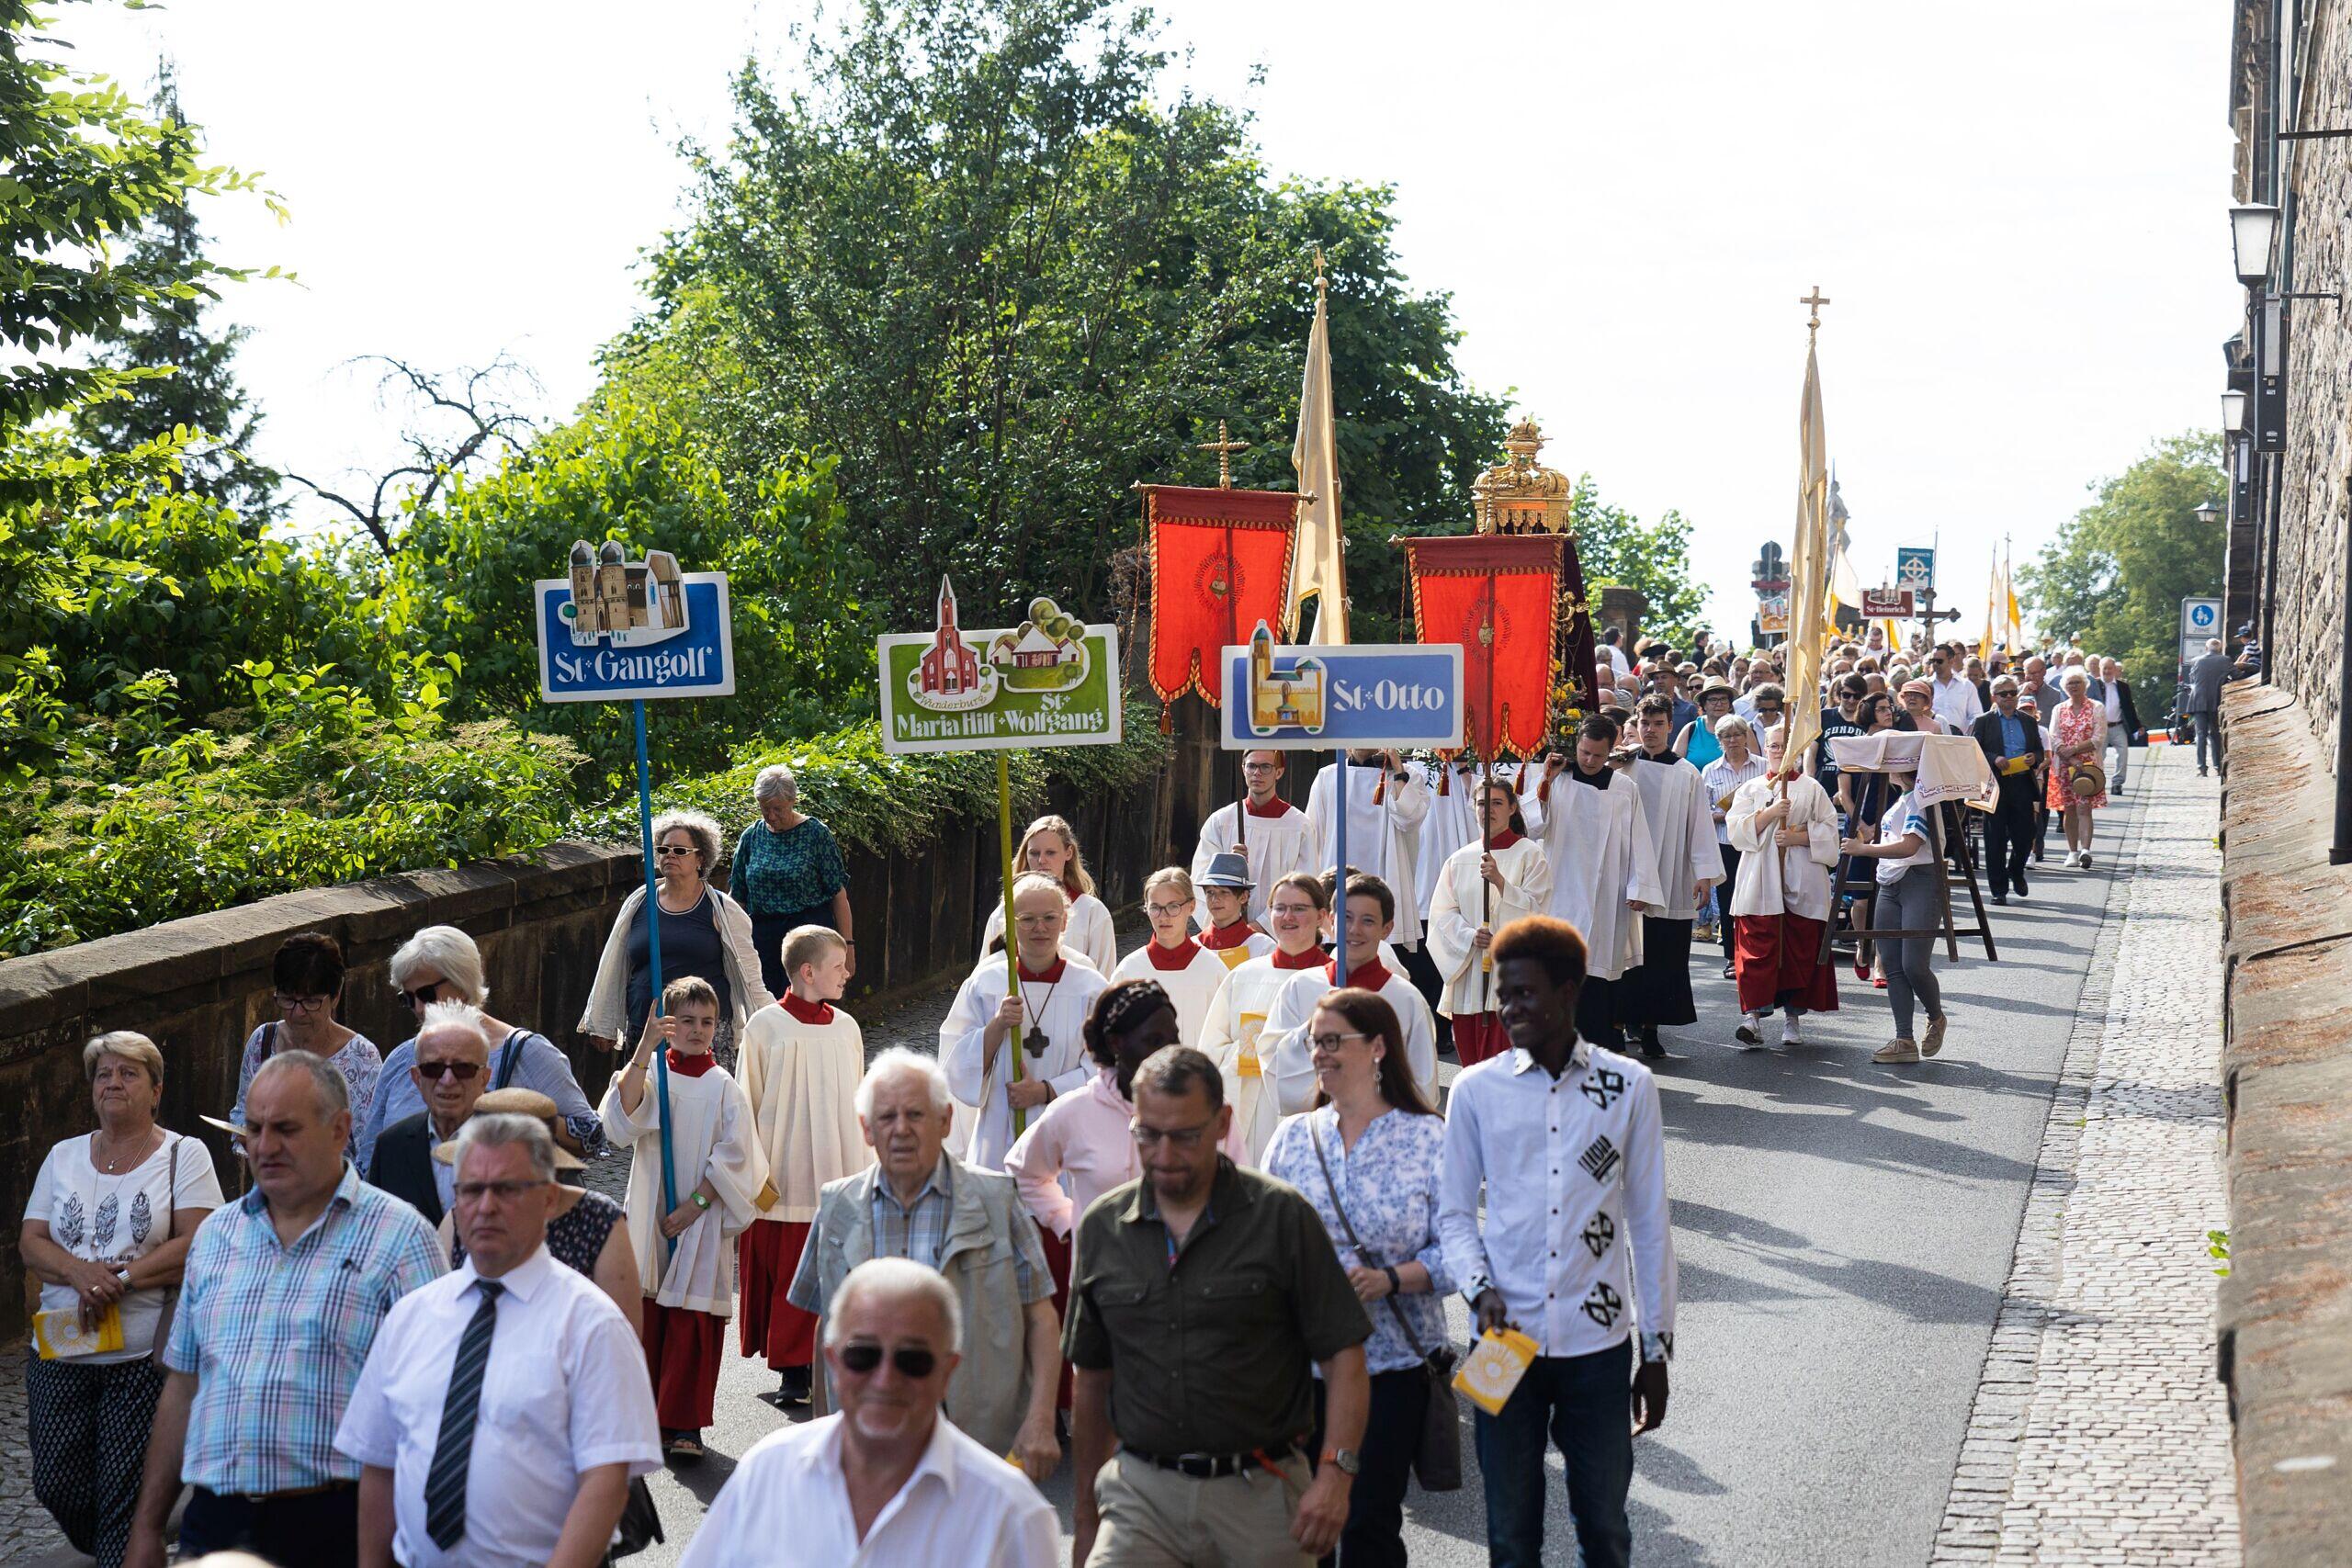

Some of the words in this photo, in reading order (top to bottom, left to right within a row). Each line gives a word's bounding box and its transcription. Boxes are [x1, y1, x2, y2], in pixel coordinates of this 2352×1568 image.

[1876, 605, 1906, 614] Heinrich
[555, 651, 587, 682] St
[594, 646, 713, 684] Gangolf
[919, 694, 987, 711] Wunderburg
[1040, 693, 1064, 711] St
[1333, 679, 1366, 712] St
[1374, 679, 1444, 711] Otto
[897, 713, 960, 738] Maria
[962, 711, 999, 736] Hilf
[1004, 707, 1103, 734] Wolfgang
